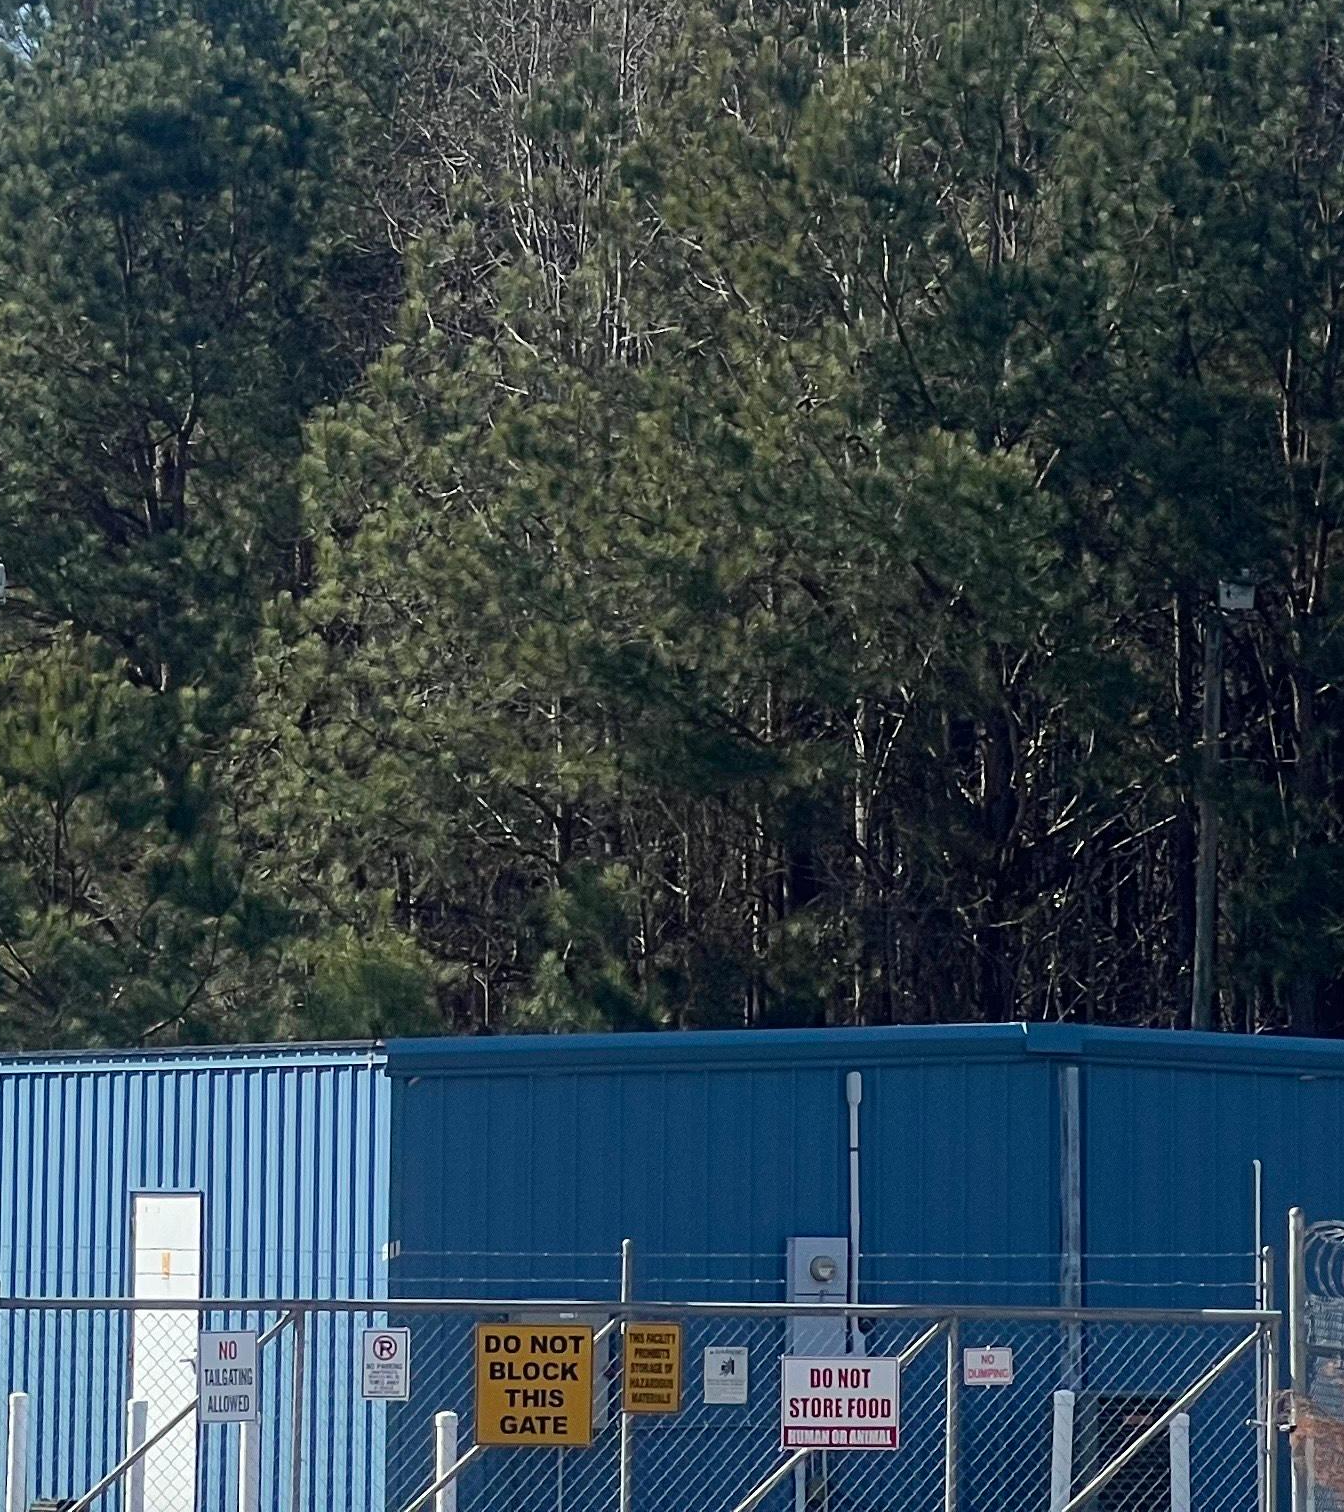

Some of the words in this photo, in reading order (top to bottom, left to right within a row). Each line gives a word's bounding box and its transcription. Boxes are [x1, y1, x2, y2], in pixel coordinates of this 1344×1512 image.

[218, 1340, 237, 1360] NO
[484, 1335, 521, 1354] DO
[530, 1335, 585, 1354] NOT
[981, 1354, 994, 1364] NO
[205, 1368, 253, 1387] TAILGATING
[489, 1362, 579, 1381] BLOCK
[810, 1369, 832, 1388] DO
[839, 1369, 871, 1388] NOT
[207, 1394, 249, 1413] ALLOWED
[504, 1389, 564, 1408] THIS
[790, 1398, 842, 1418] STORE
[848, 1399, 891, 1418] FOOD
[500, 1416, 567, 1435] GATE
[788, 1429, 830, 1445] HUMAN
[849, 1429, 892, 1445] ANIMAL
